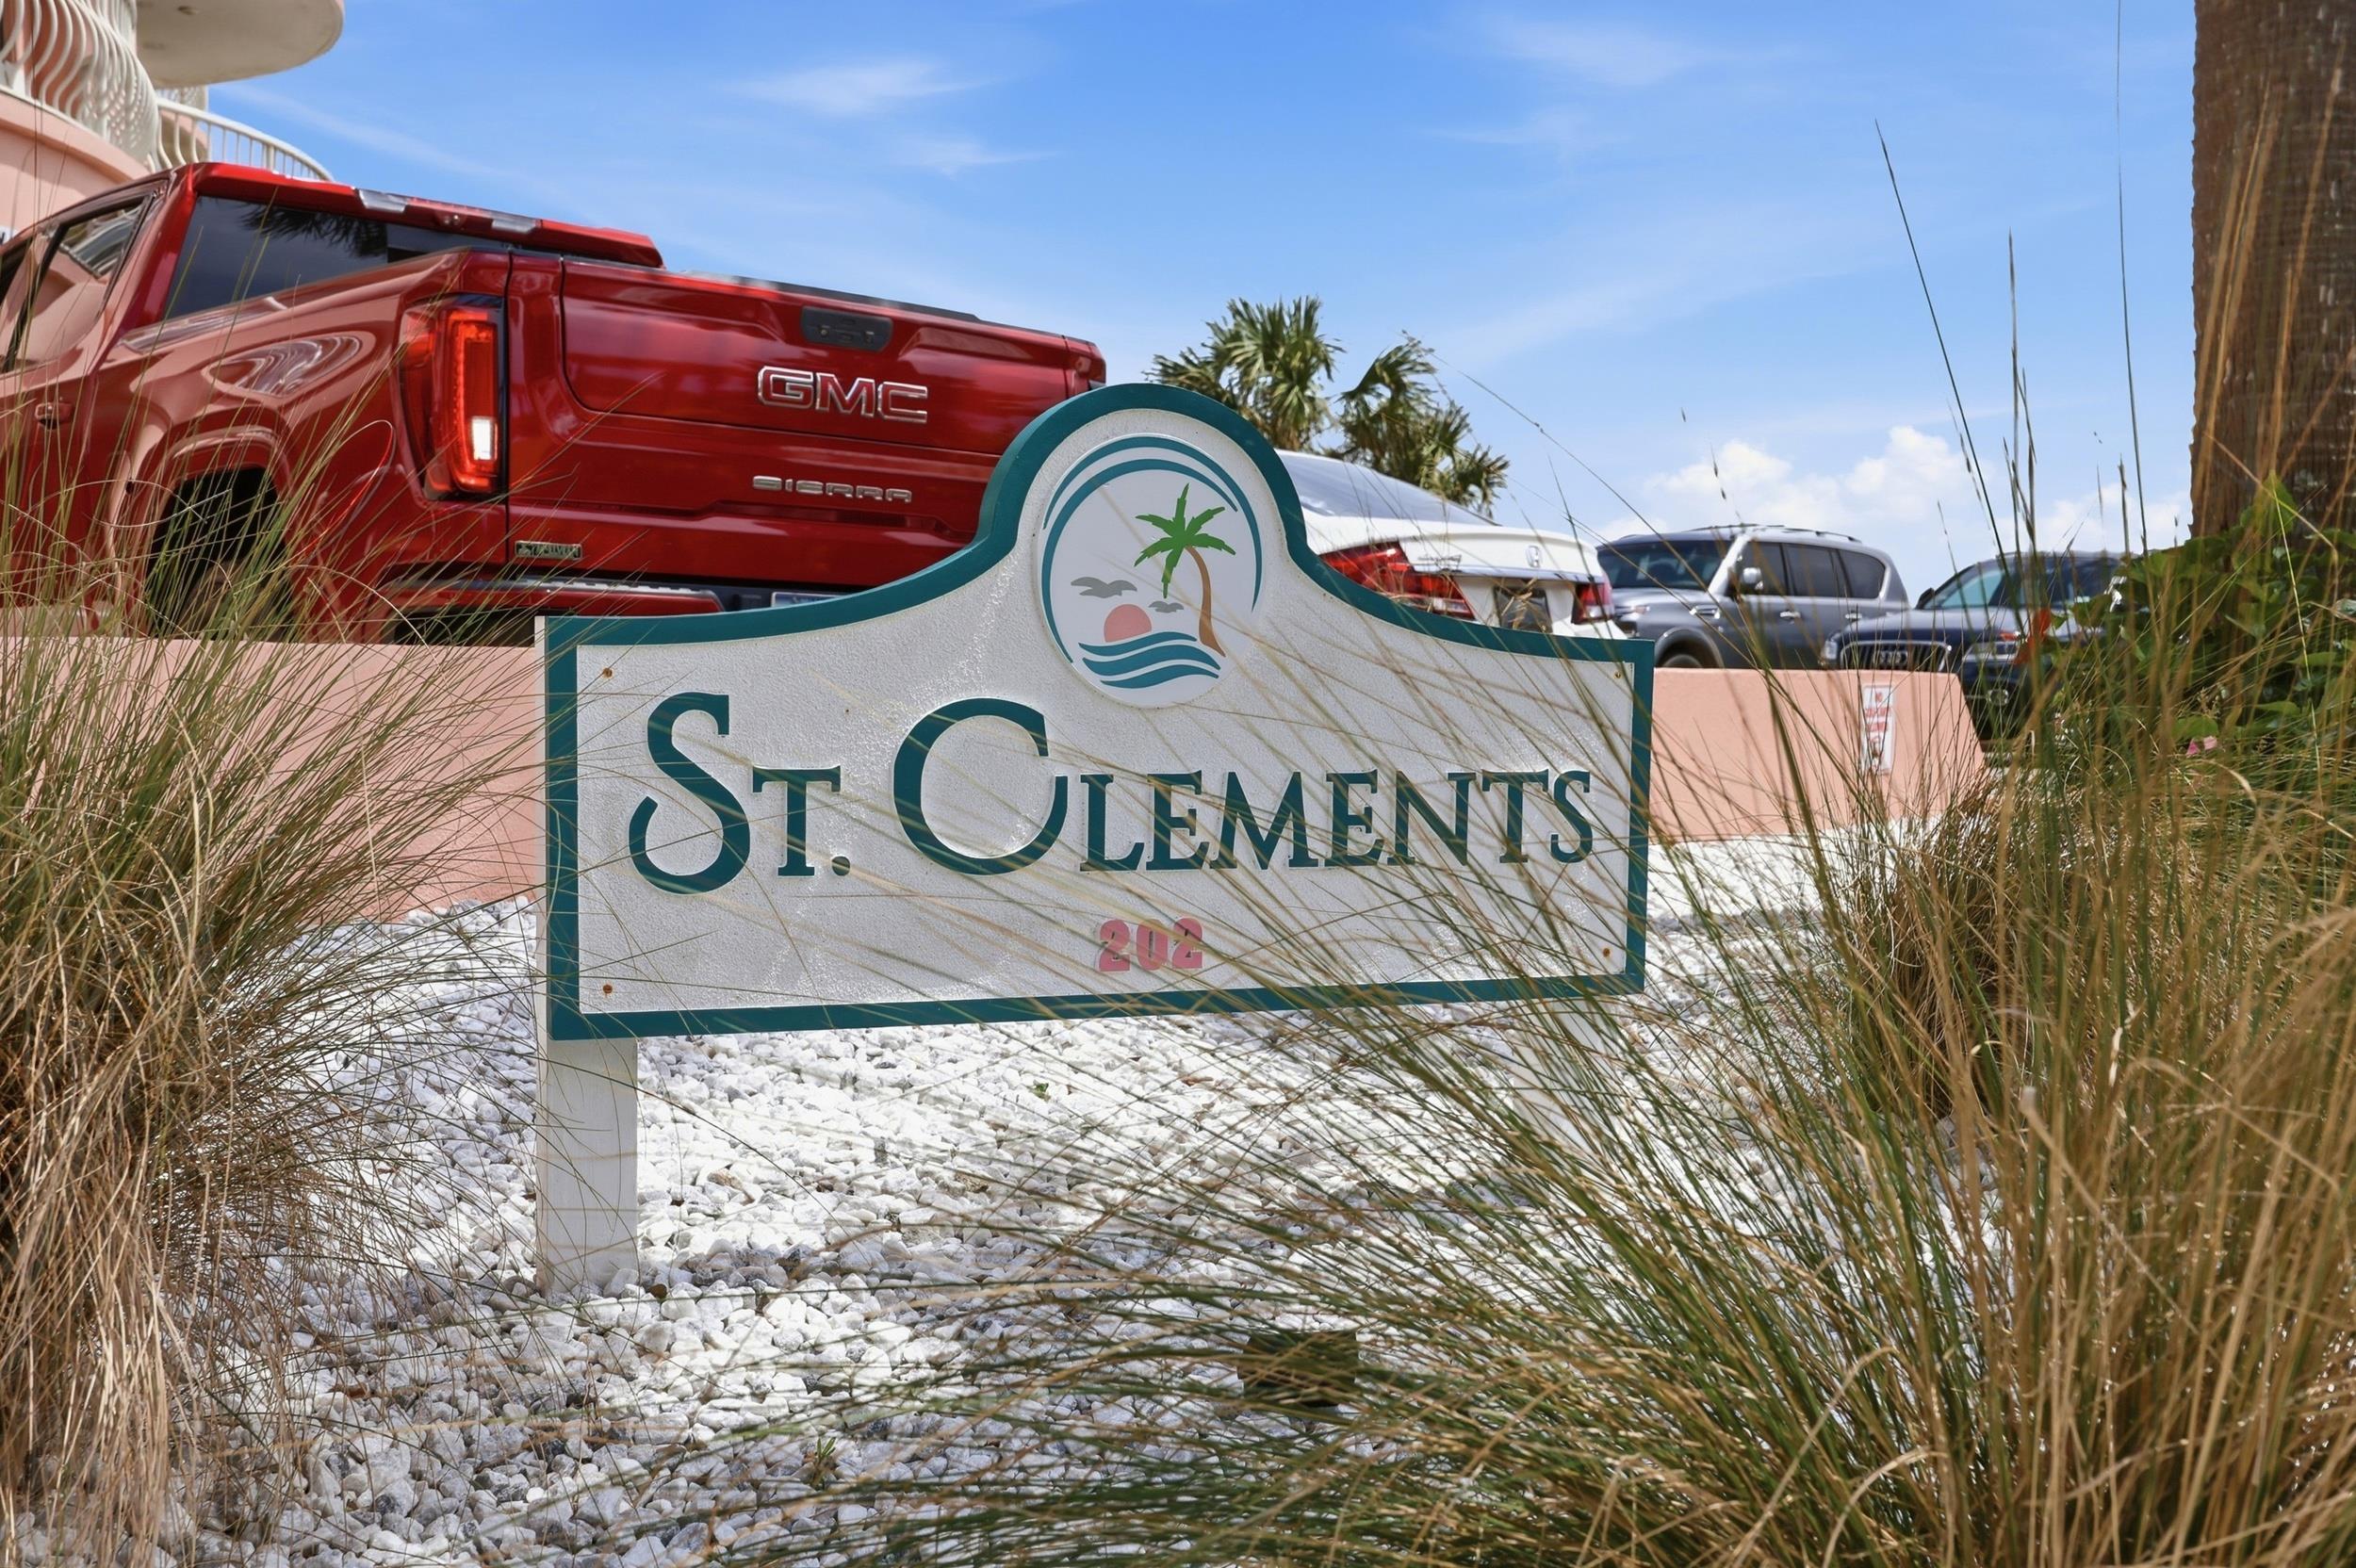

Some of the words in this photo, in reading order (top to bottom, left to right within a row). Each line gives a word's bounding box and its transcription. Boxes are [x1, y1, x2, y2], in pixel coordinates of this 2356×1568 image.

[758, 366, 928, 423] GMC
[753, 475, 912, 503] SIERRA
[629, 692, 850, 895] ST.
[893, 697, 1595, 875] CLEMENTS
[1099, 917, 1203, 972] 202
